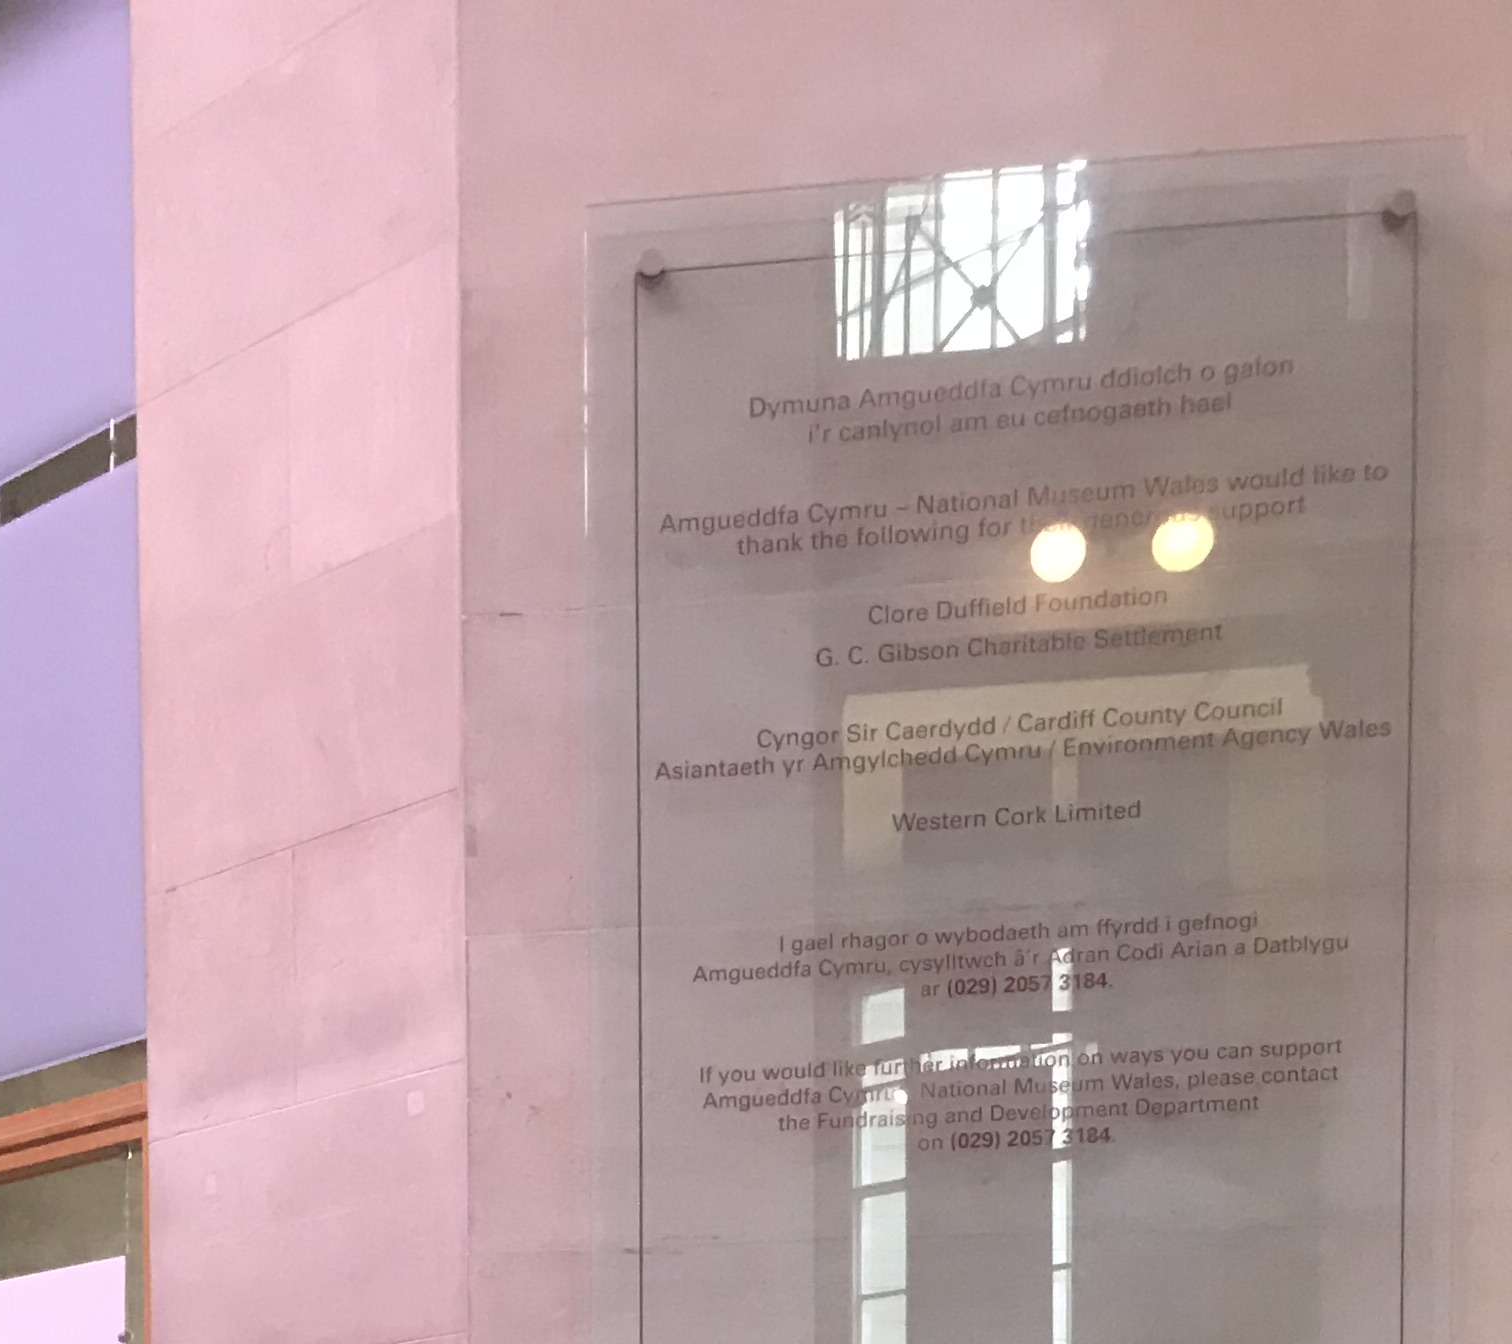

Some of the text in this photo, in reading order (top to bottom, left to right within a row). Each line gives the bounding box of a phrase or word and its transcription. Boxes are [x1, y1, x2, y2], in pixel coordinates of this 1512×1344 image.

[869, 590, 1167, 623] Clore Duffield Foundation
[816, 625, 1222, 666] G. C. Gibson Charitable Settlement
[757, 698, 1283, 750] Cyngor Sir Caerdydd / Cardiff County Council
[655, 756, 774, 780] Asiantaeth
[782, 759, 804, 778] yr
[812, 745, 959, 773] Amgylchedd
[964, 744, 1041, 765] Cymru
[1064, 730, 1214, 755] Environment
[1222, 728, 1312, 750] Agency
[1319, 720, 1391, 740] Wales
[892, 803, 1141, 830] Western Cork Limited
[693, 959, 811, 984] Amgueddfa
[898, 950, 1006, 975] cysylltwch
[1050, 947, 1110, 964] Adran
[1116, 943, 1164, 961] Codi
[1170, 941, 1228, 959] Arian
[1234, 943, 1246, 956] a
[1254, 936, 1349, 957] Datblygu
